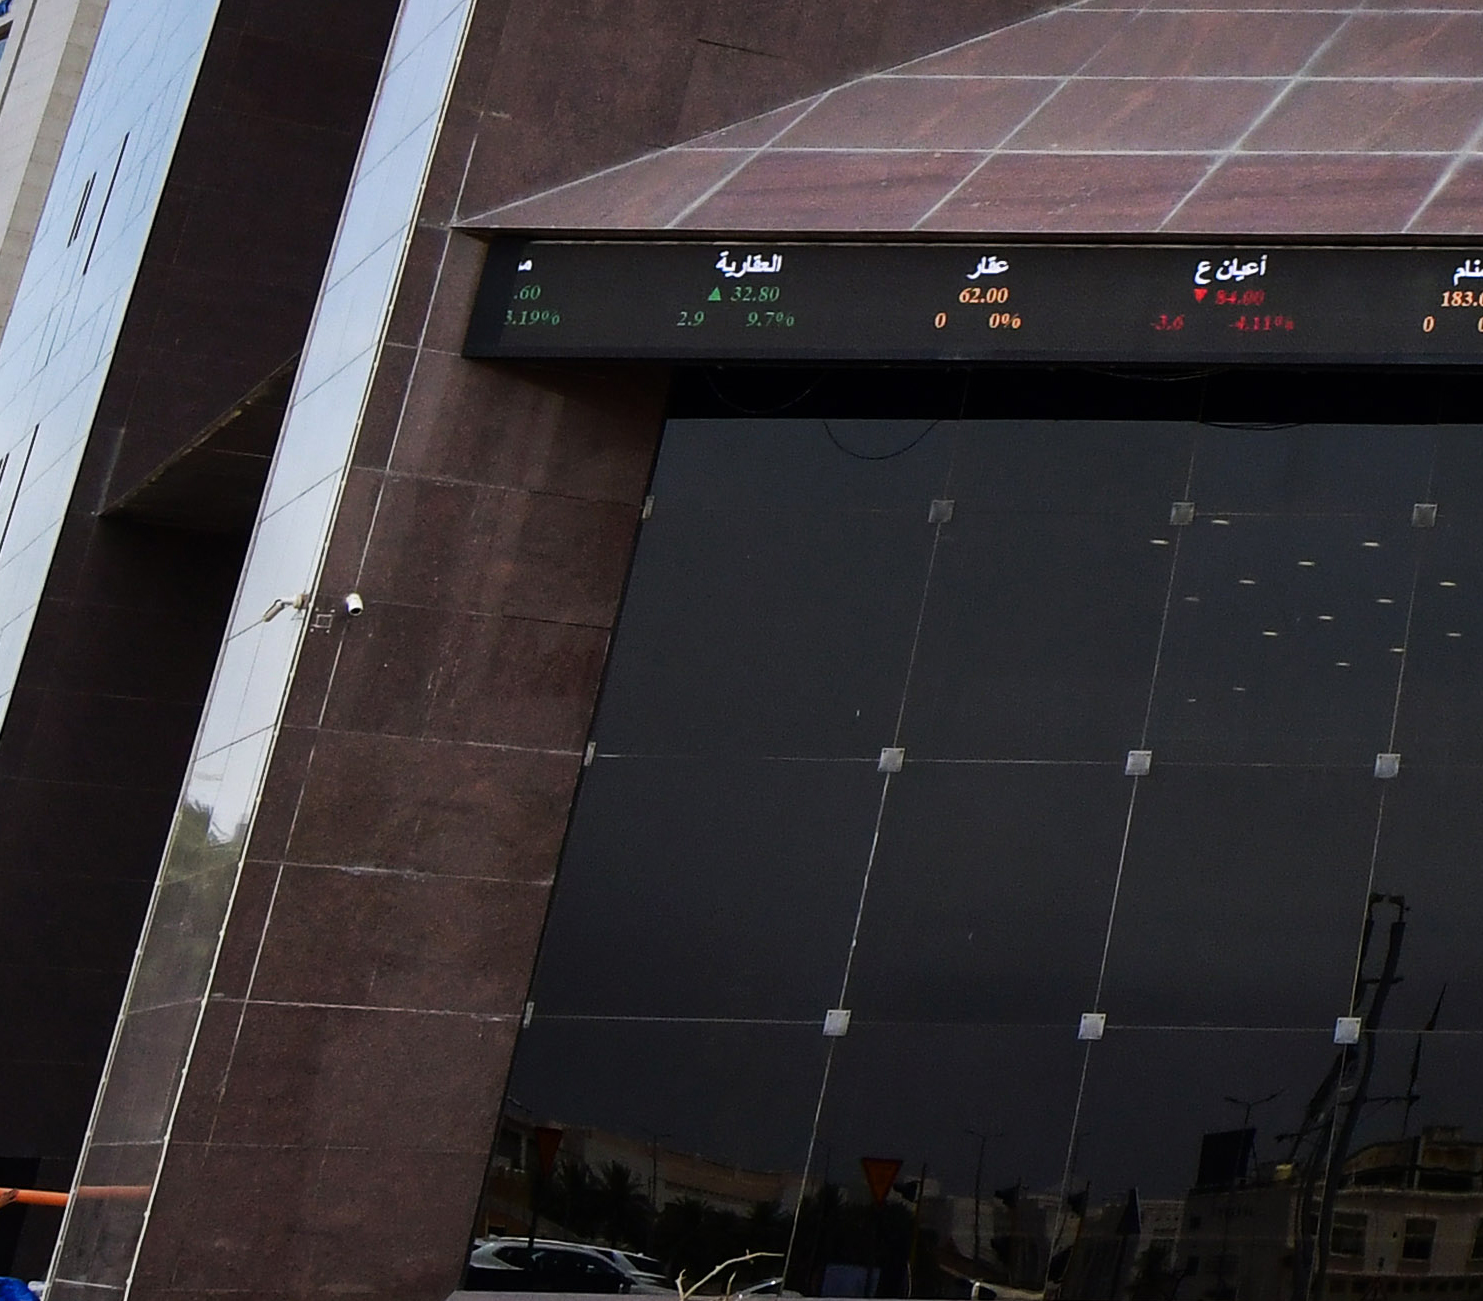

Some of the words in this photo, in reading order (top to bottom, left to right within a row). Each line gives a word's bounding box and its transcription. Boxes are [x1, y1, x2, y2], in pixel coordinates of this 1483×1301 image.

[715, 250, 783, 278] العقارية
[966, 255, 1009, 280] عقار
[730, 286, 780, 302] 32.80
[958, 287, 1009, 304] 62.00
[676, 310, 705, 327] 2.9
[745, 311, 795, 327] 9.7%
[934, 312, 947, 329] 0
[989, 312, 1022, 329] 0%
[1422, 315, 1435, 333] 0
